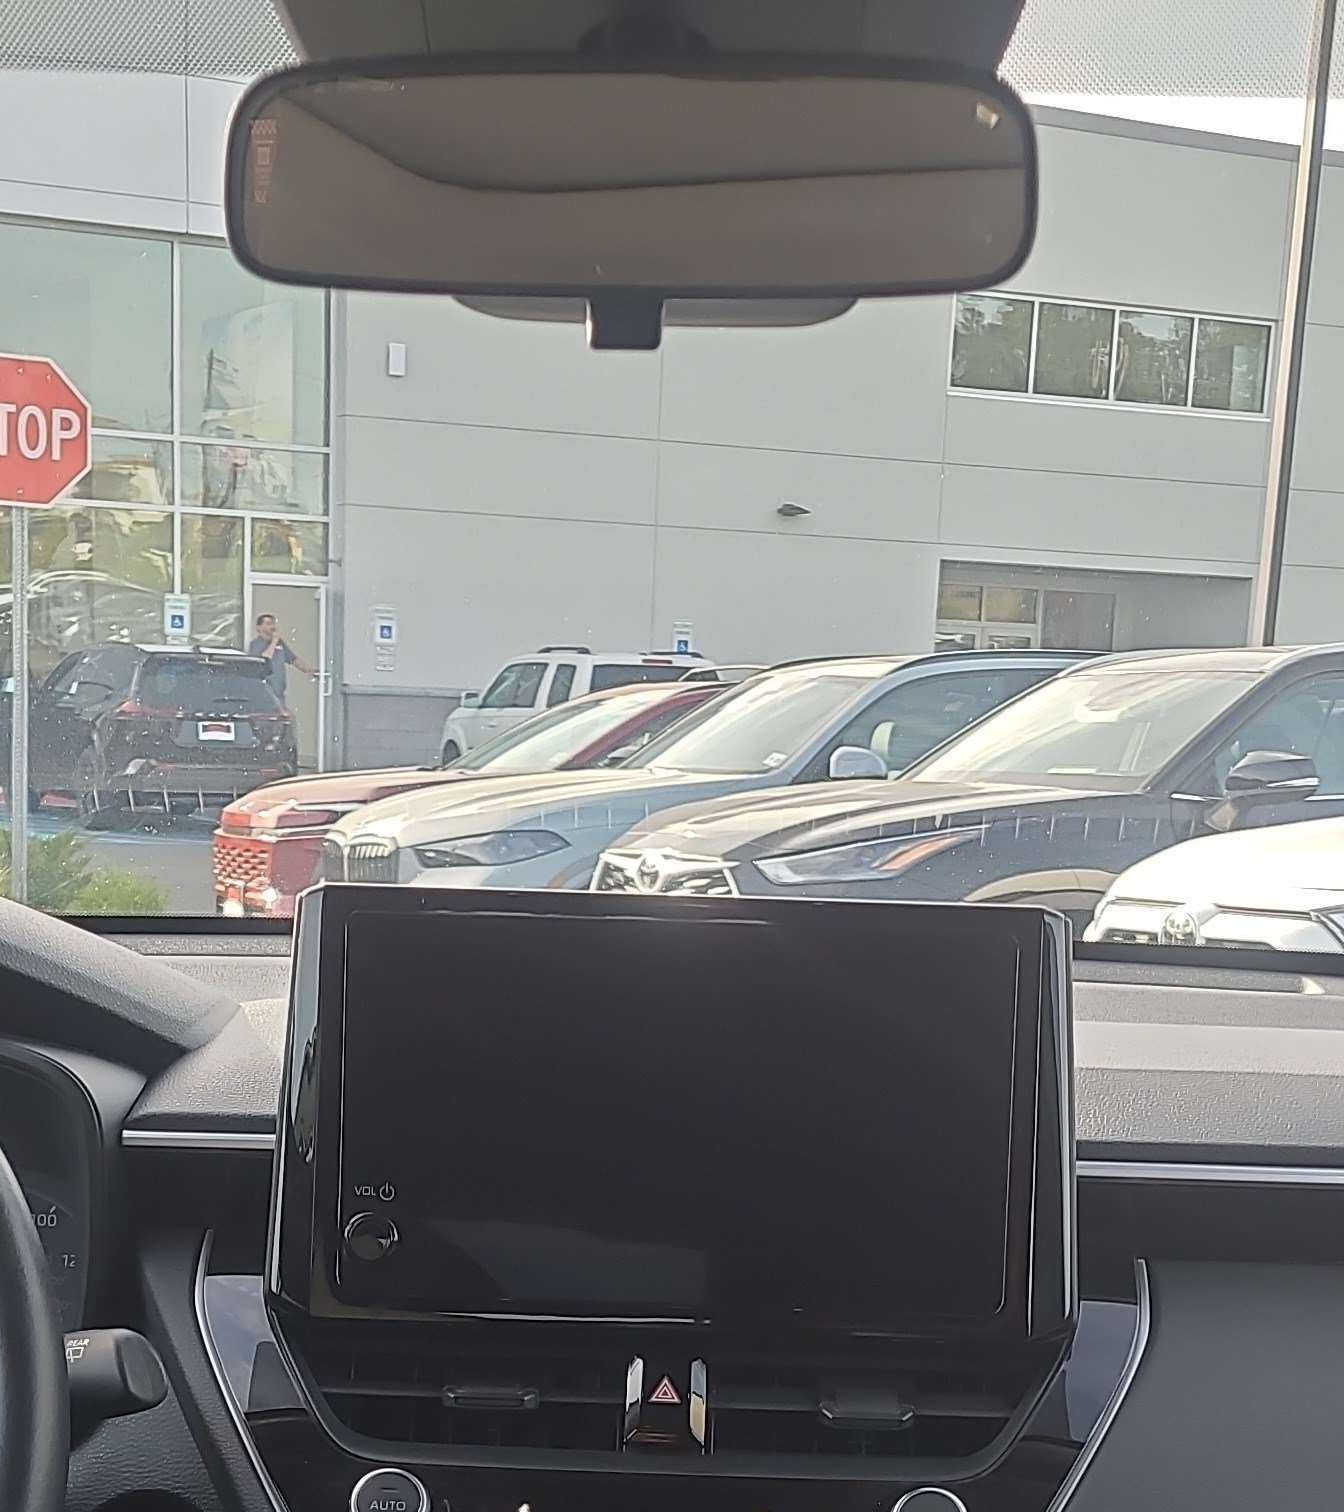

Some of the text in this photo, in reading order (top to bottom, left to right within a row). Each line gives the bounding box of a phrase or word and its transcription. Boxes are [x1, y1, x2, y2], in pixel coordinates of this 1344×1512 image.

[354, 1185, 376, 1196] VOL
[66, 1338, 90, 1348] REAR
[369, 1500, 406, 1511] AUTO
